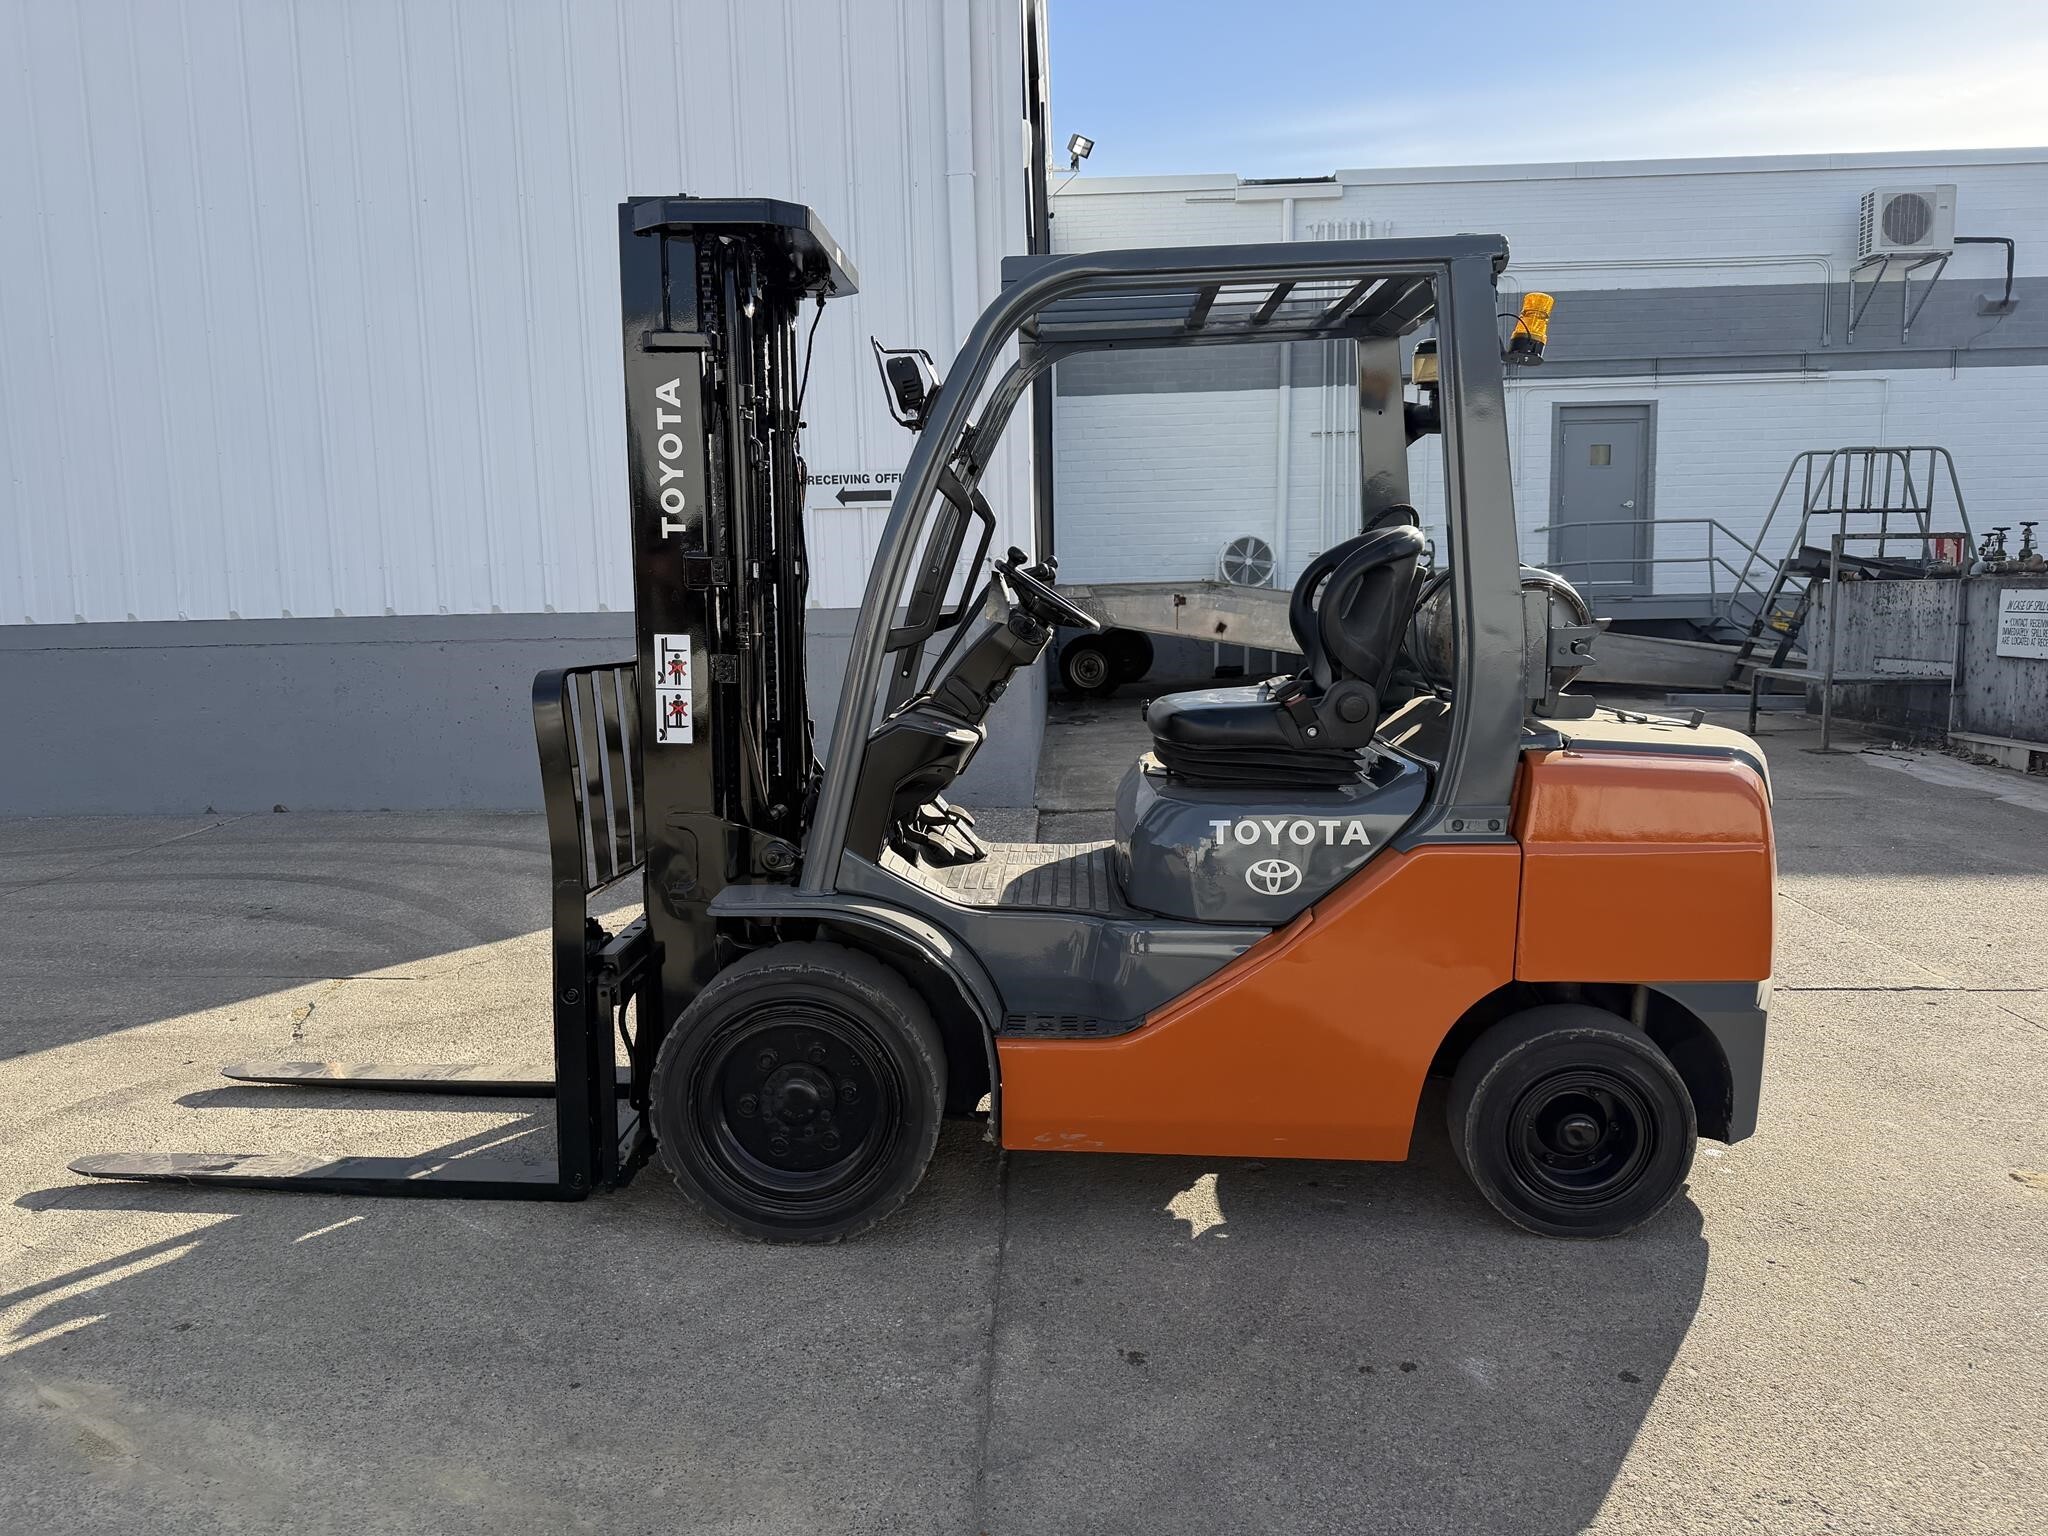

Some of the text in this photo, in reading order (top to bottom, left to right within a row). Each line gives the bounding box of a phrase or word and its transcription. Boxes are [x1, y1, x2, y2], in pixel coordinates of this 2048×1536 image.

[655, 377, 687, 539] TOYOTA
[807, 473, 902, 485] RECEIVING OFFI
[2013, 600, 2026, 610] CASE
[1208, 820, 1371, 846] TOYOTA
